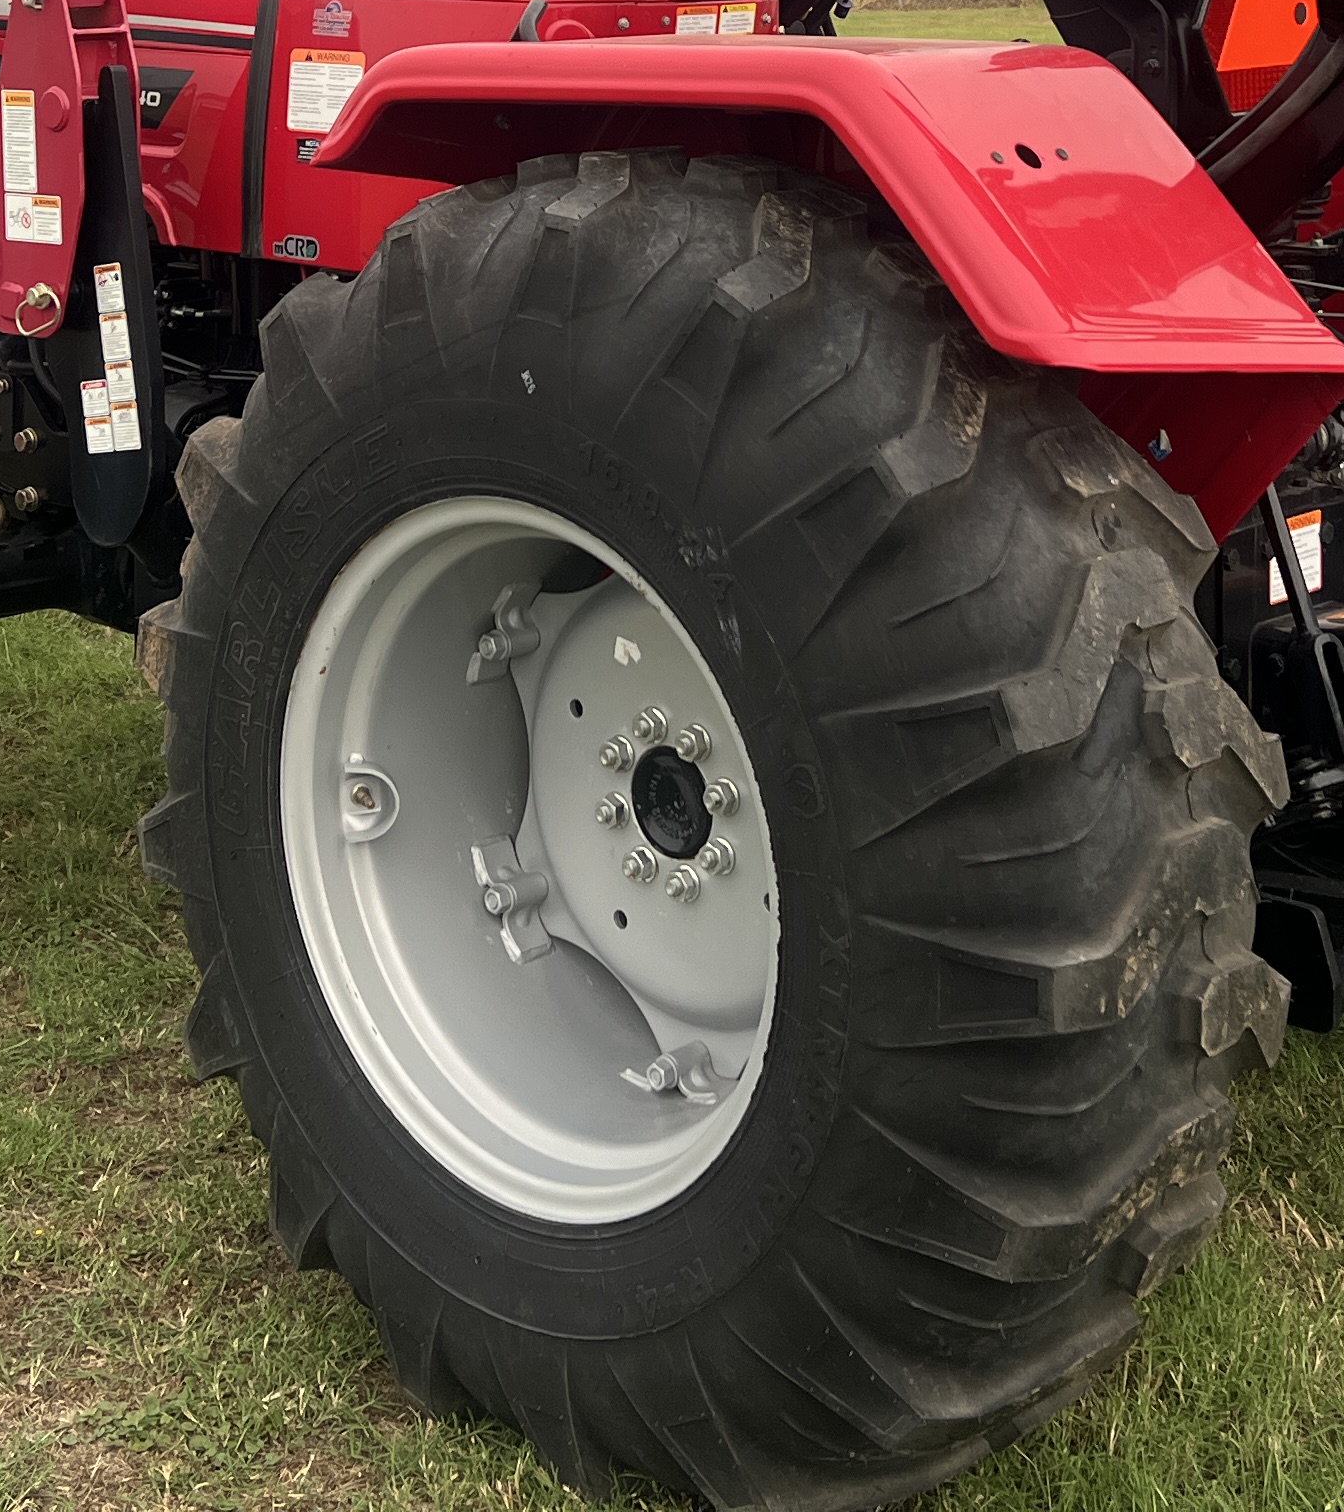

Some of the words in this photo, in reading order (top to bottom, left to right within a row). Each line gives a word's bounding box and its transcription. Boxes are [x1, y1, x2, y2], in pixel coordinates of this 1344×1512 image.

[317, 52, 351, 63] WARNING
[274, 237, 318, 259] mCRD
[1290, 513, 1316, 528] ARNING
[212, 421, 400, 837] CARLISLE
